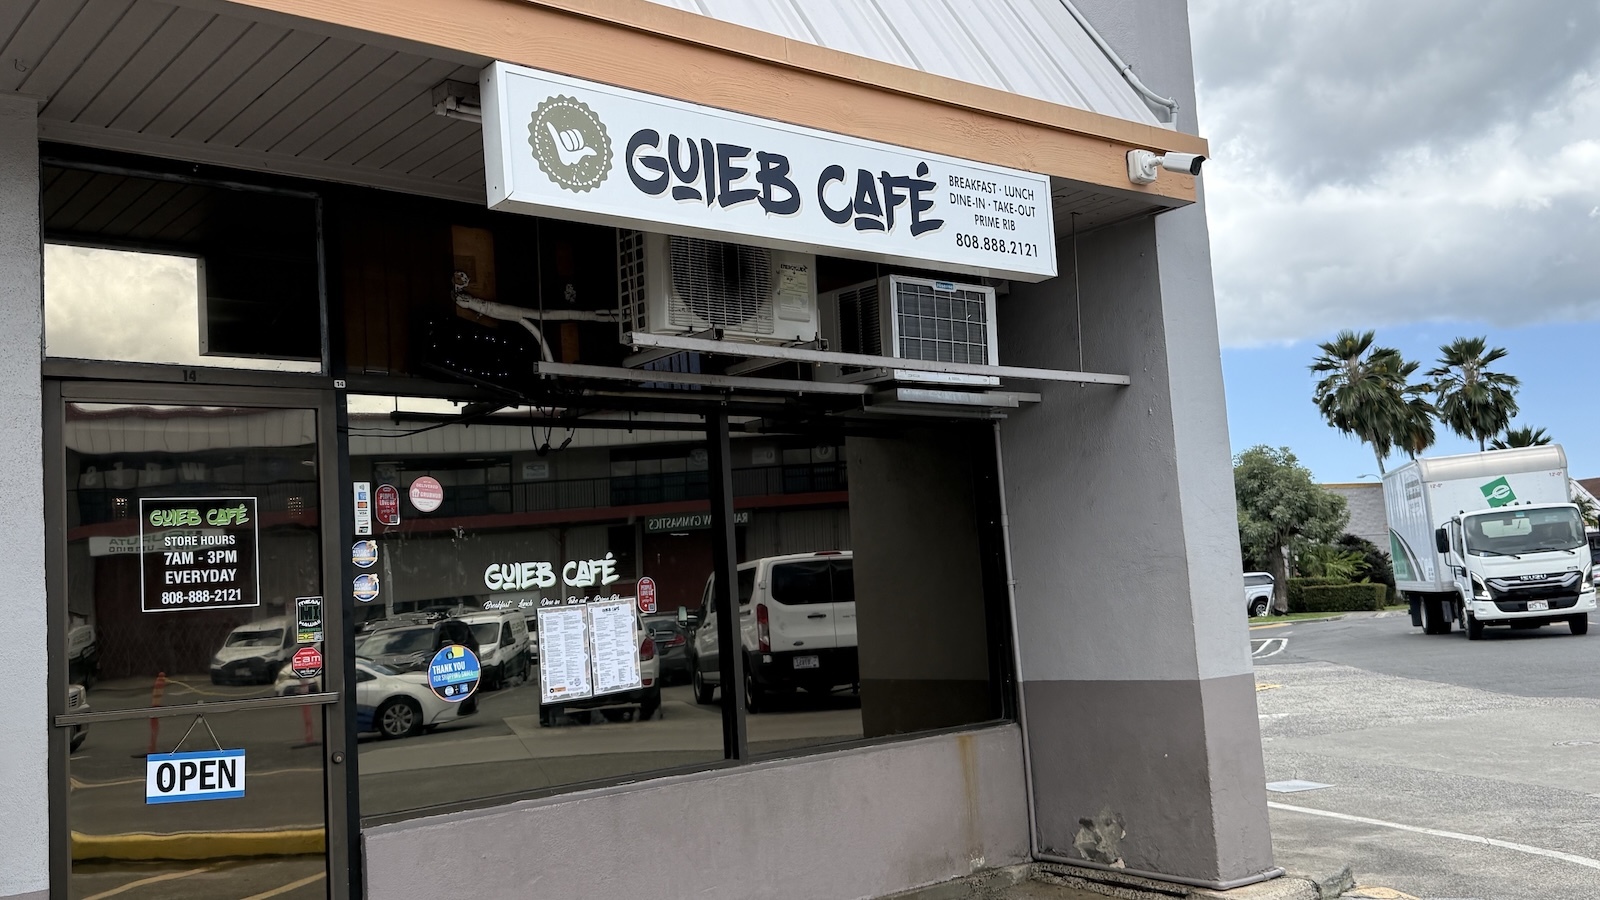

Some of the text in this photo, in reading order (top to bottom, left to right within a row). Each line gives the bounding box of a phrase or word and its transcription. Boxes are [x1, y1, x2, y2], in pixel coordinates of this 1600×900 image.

[625, 128, 945, 237] GUIEB CAFÉ
[949, 175, 996, 194] BREAKFAST
[1004, 185, 1034, 201] LUNCH
[949, 192, 986, 209] DINE-IN
[993, 200, 1036, 218] TAKE-OUT
[974, 214, 1016, 231] PRIME RIB
[956, 233, 1038, 257] 808.888.2121
[183, 369, 197, 382] 14
[149, 503, 249, 527] GUIEB CAFÉ
[164, 535, 235, 546] STORE HOURS
[164, 551, 194, 565] 7AM
[207, 550, 237, 563] 3PM
[165, 568, 237, 584] EVERYDAY
[484, 551, 620, 591] GUIEB CAFÉ
[161, 588, 241, 604] 808-888-2121
[483, 600, 513, 610] Breakfast
[518, 598, 533, 608] Lunch
[294, 655, 320, 664] cam
[432, 661, 466, 675] THANK YOU
[156, 759, 236, 793] OPEN
